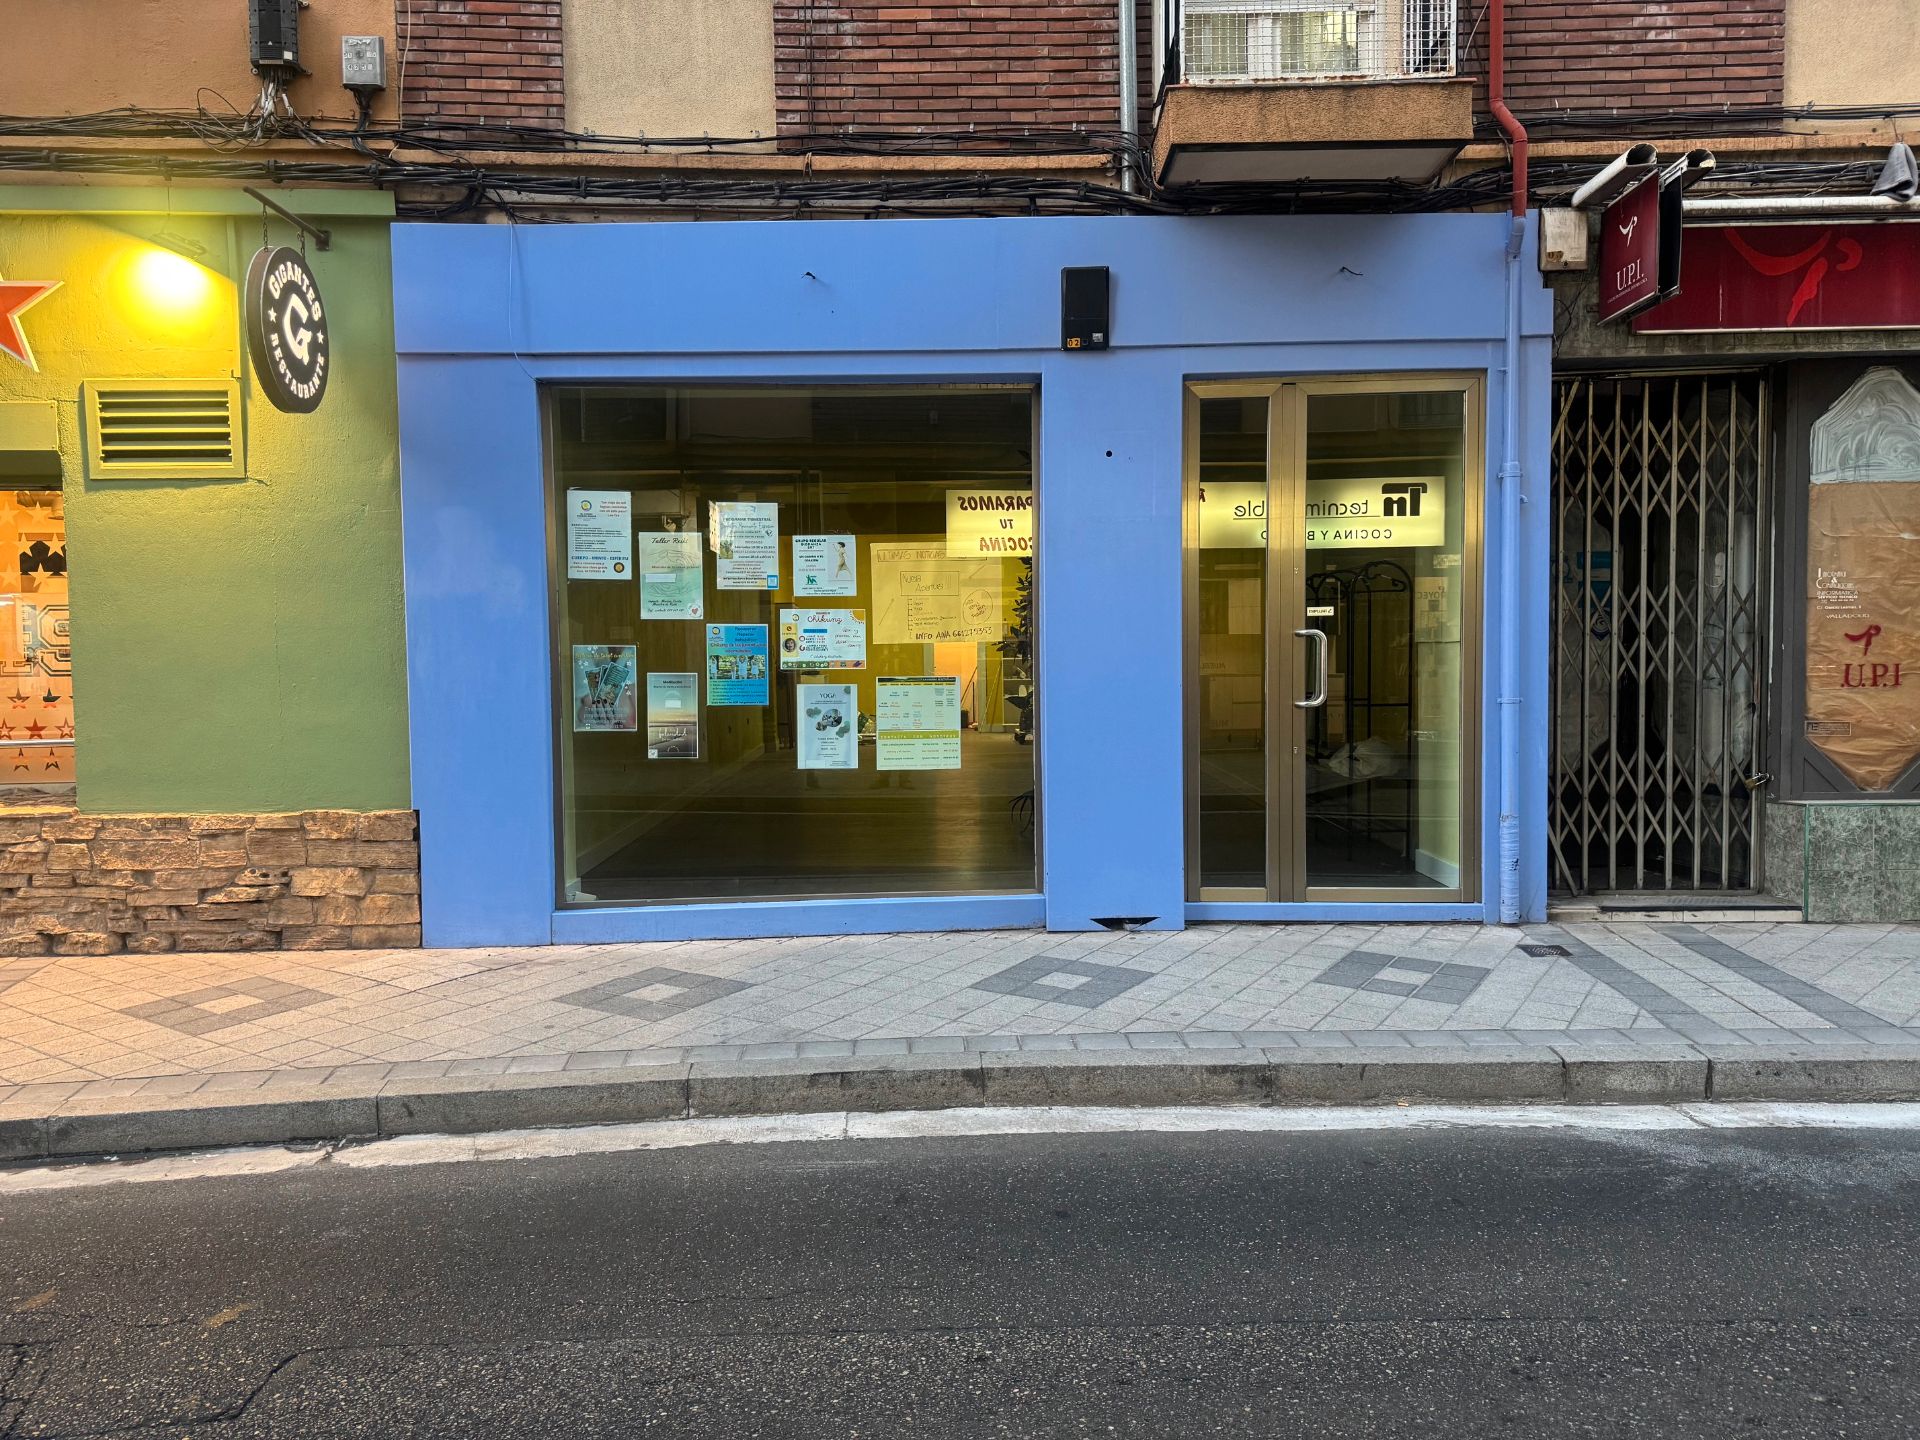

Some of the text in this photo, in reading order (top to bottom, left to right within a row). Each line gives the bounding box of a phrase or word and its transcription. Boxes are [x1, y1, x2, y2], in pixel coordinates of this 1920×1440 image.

[268, 261, 322, 322] GIGANTES
[1616, 258, 1644, 291] U.P.I.
[283, 293, 312, 366] G
[270, 332, 325, 399] RESTAURANTE
